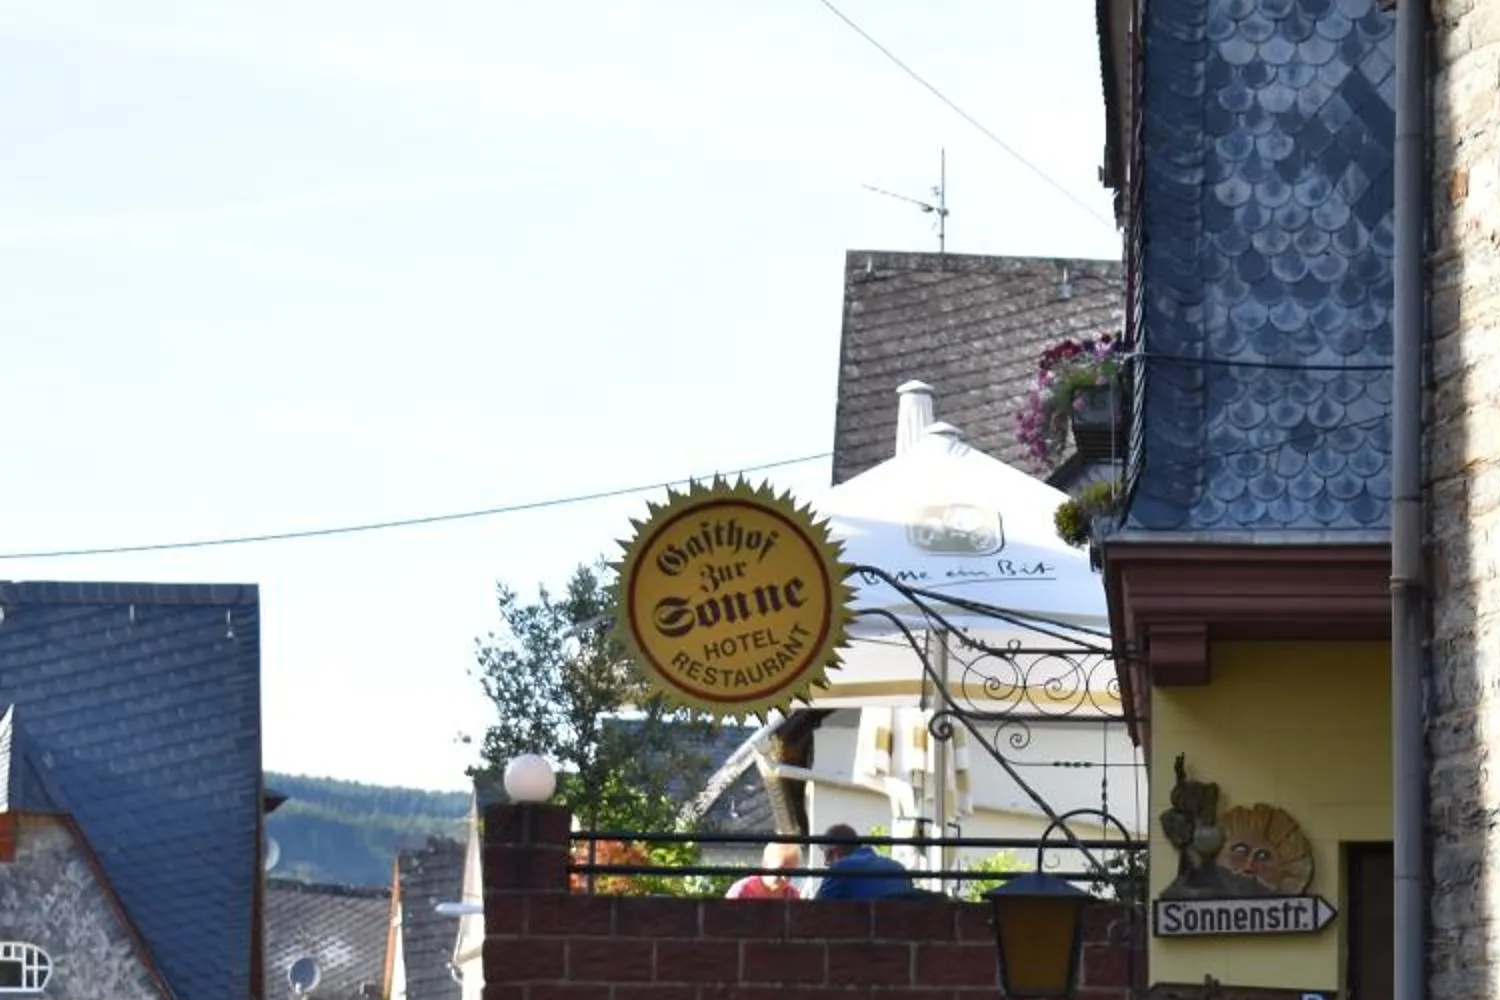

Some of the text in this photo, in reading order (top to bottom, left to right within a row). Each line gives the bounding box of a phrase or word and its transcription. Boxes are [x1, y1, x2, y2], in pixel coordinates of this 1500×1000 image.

[656, 518, 780, 576] Gasthof
[700, 560, 747, 593] Zur
[860, 569, 932, 585] Btte
[654, 576, 808, 638] Sonne
[671, 623, 811, 688] RESTAURANT
[703, 627, 781, 662] HOTEL
[1163, 901, 1309, 932] Sonnenstr.
